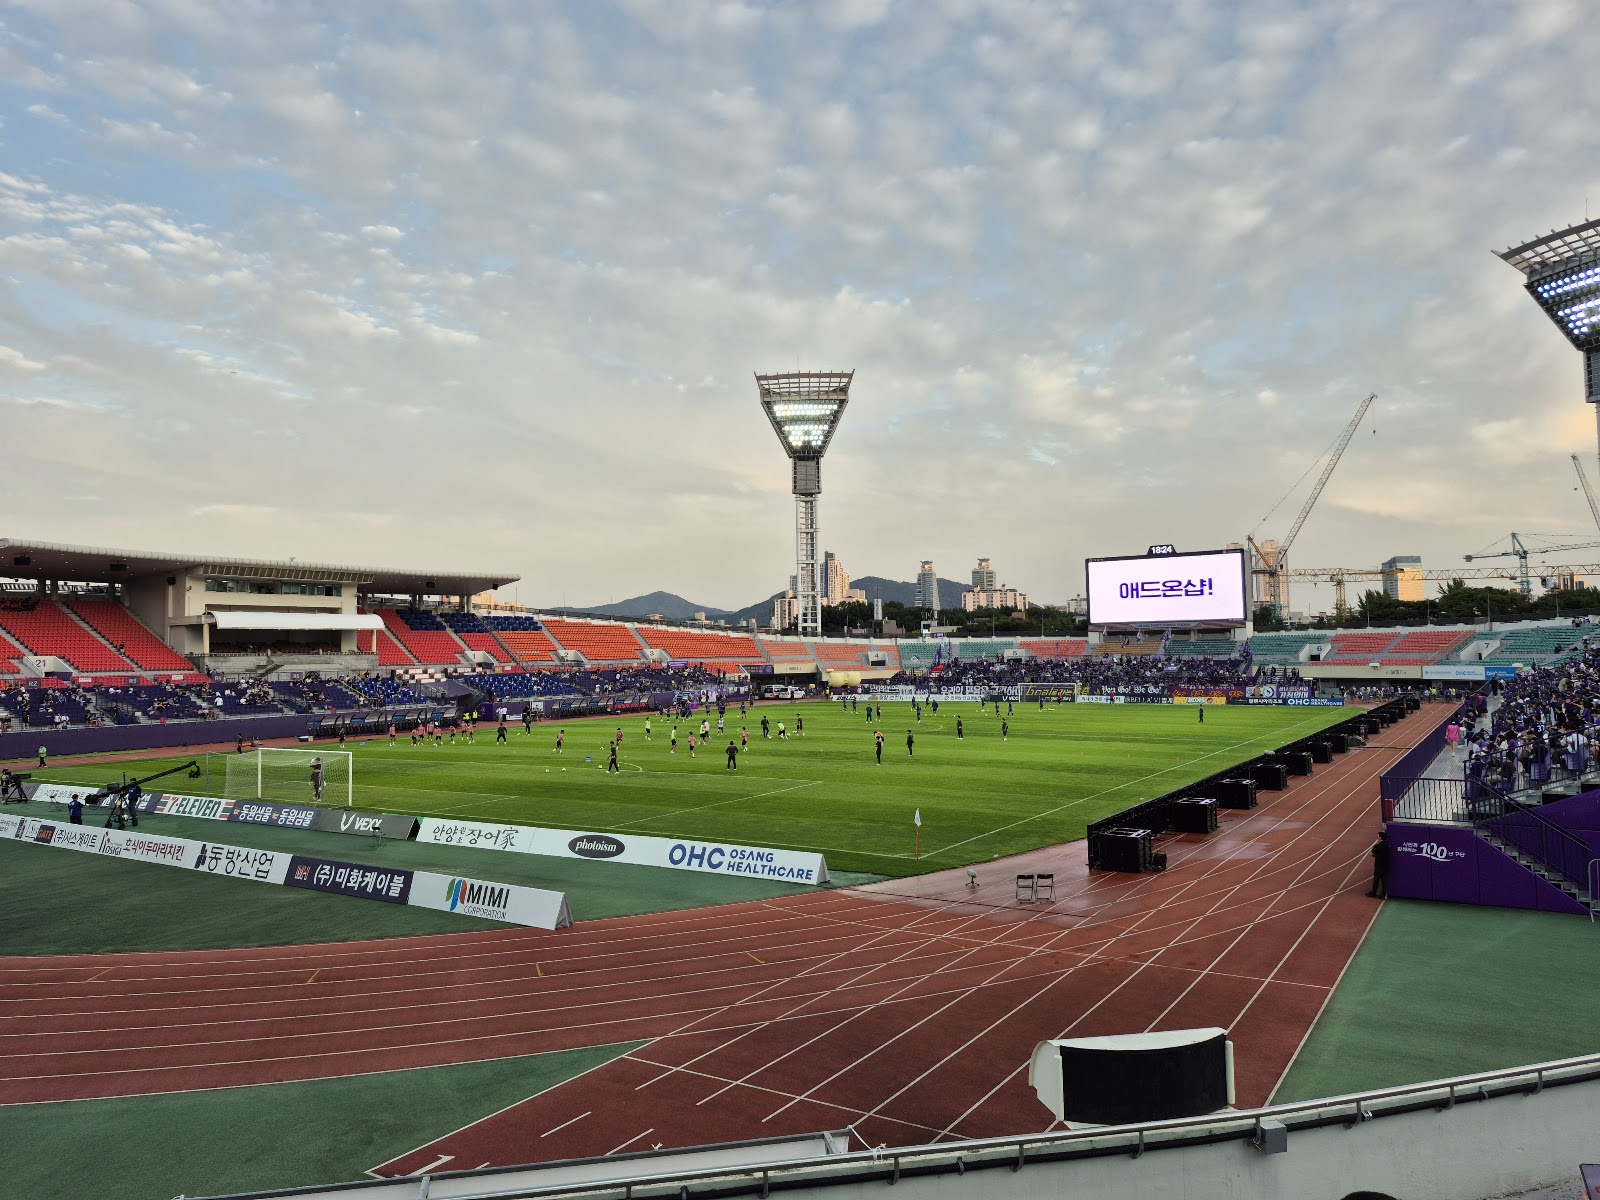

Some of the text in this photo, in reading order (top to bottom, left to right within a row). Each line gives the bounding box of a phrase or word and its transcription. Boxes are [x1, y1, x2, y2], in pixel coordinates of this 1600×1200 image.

[1151, 545, 1173, 554] 18:24
[1119, 577, 1213, 599] 애드온샵!
[35, 659, 47, 668] 21
[238, 804, 314, 827] 동원샘물 동원샘물
[37, 829, 53, 839] GATE
[433, 824, 458, 843] 안양
[123, 837, 185, 861] 호식이두마리치킨
[575, 838, 617, 853] photoism
[207, 846, 274, 879] 동방산업
[668, 843, 774, 870] OHC OSANG
[313, 862, 405, 898] (주)미화케이블
[726, 861, 814, 881] HEALTHCARE
[466, 882, 511, 910] MIMI
[463, 904, 508, 920] CORPORATION
